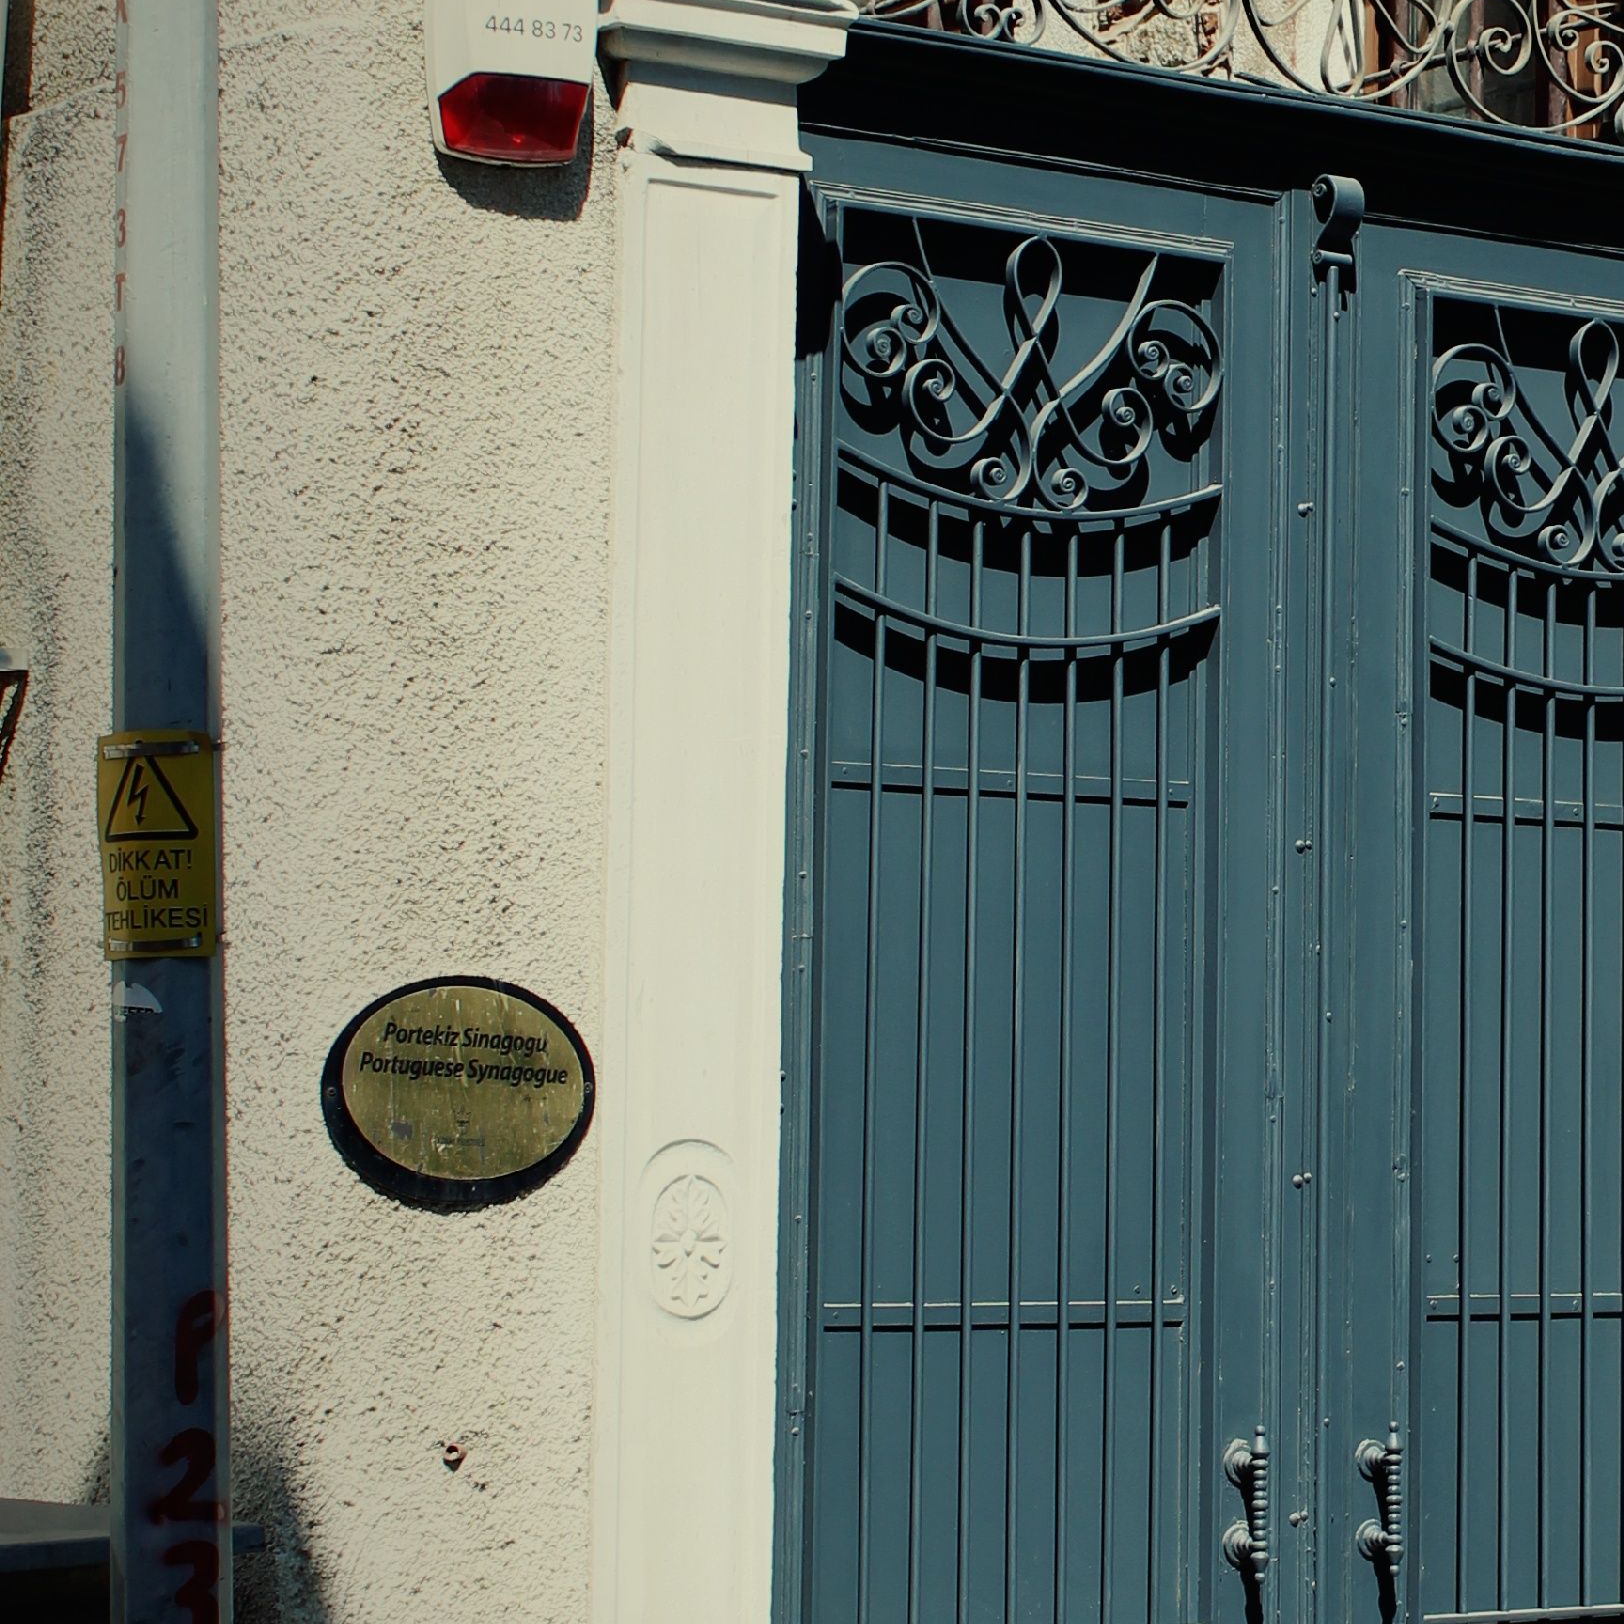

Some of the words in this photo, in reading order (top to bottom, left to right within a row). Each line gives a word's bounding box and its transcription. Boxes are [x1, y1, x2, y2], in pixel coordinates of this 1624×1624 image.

[485, 15, 525, 36] 444
[531, 19, 556, 39] 83
[562, 23, 583, 43] 73
[109, 847, 193, 874] DİKKAT!
[115, 876, 180, 902] ÖLÜM
[105, 904, 209, 932] TEHLİKESİ
[383, 1021, 461, 1048] Portekiz
[461, 1027, 549, 1057] Sinagogu
[359, 1051, 465, 1081] Portuguese
[466, 1059, 569, 1089] Synagogue
